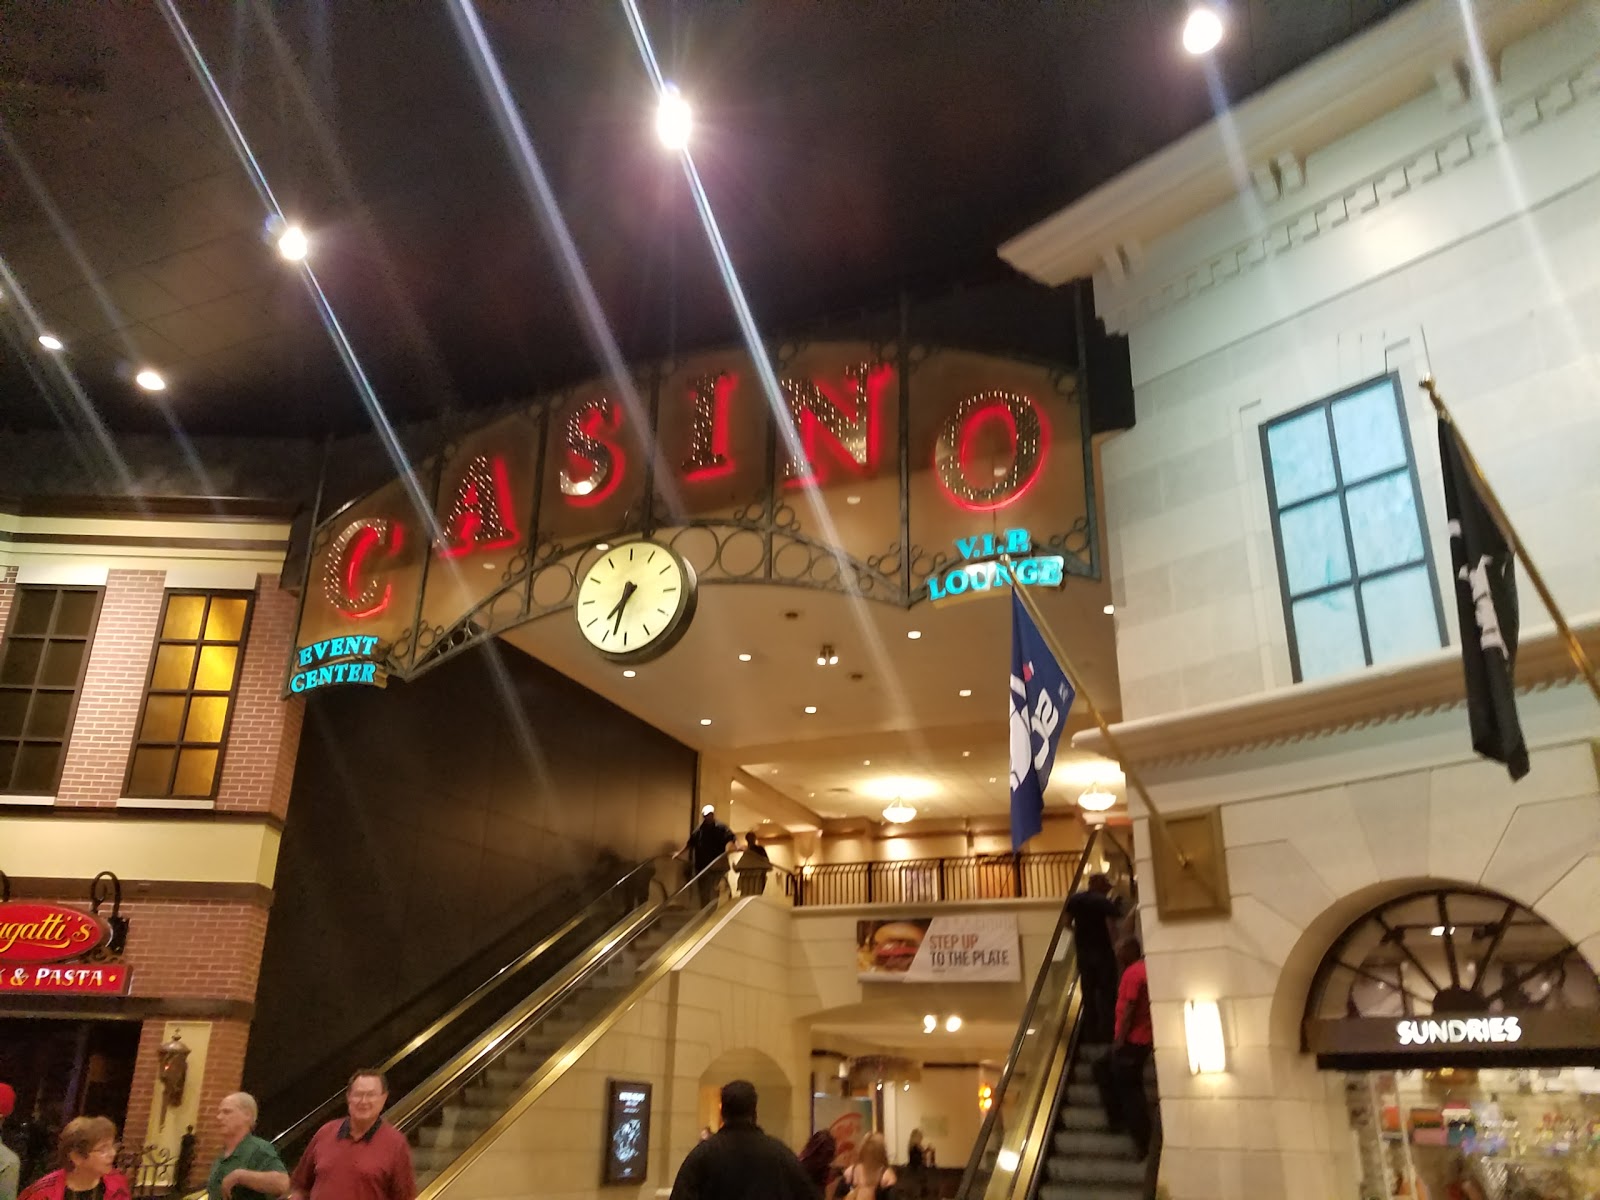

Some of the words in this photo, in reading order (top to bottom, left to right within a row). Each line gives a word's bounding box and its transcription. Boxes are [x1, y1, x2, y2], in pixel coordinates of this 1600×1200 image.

[323, 360, 1050, 621] CASINO
[927, 556, 1064, 601] LOUNGE
[299, 635, 378, 666] EVENT
[291, 663, 376, 693] CENTER
[929, 934, 960, 950] STEP
[962, 933, 979, 949] UP
[930, 951, 945, 967] TO
[948, 951, 970, 967] THE
[972, 950, 1009, 966] PLATE
[10, 967, 29, 986] &
[34, 967, 103, 987] PASTA
[1396, 1016, 1522, 1045] SUNDRIES
